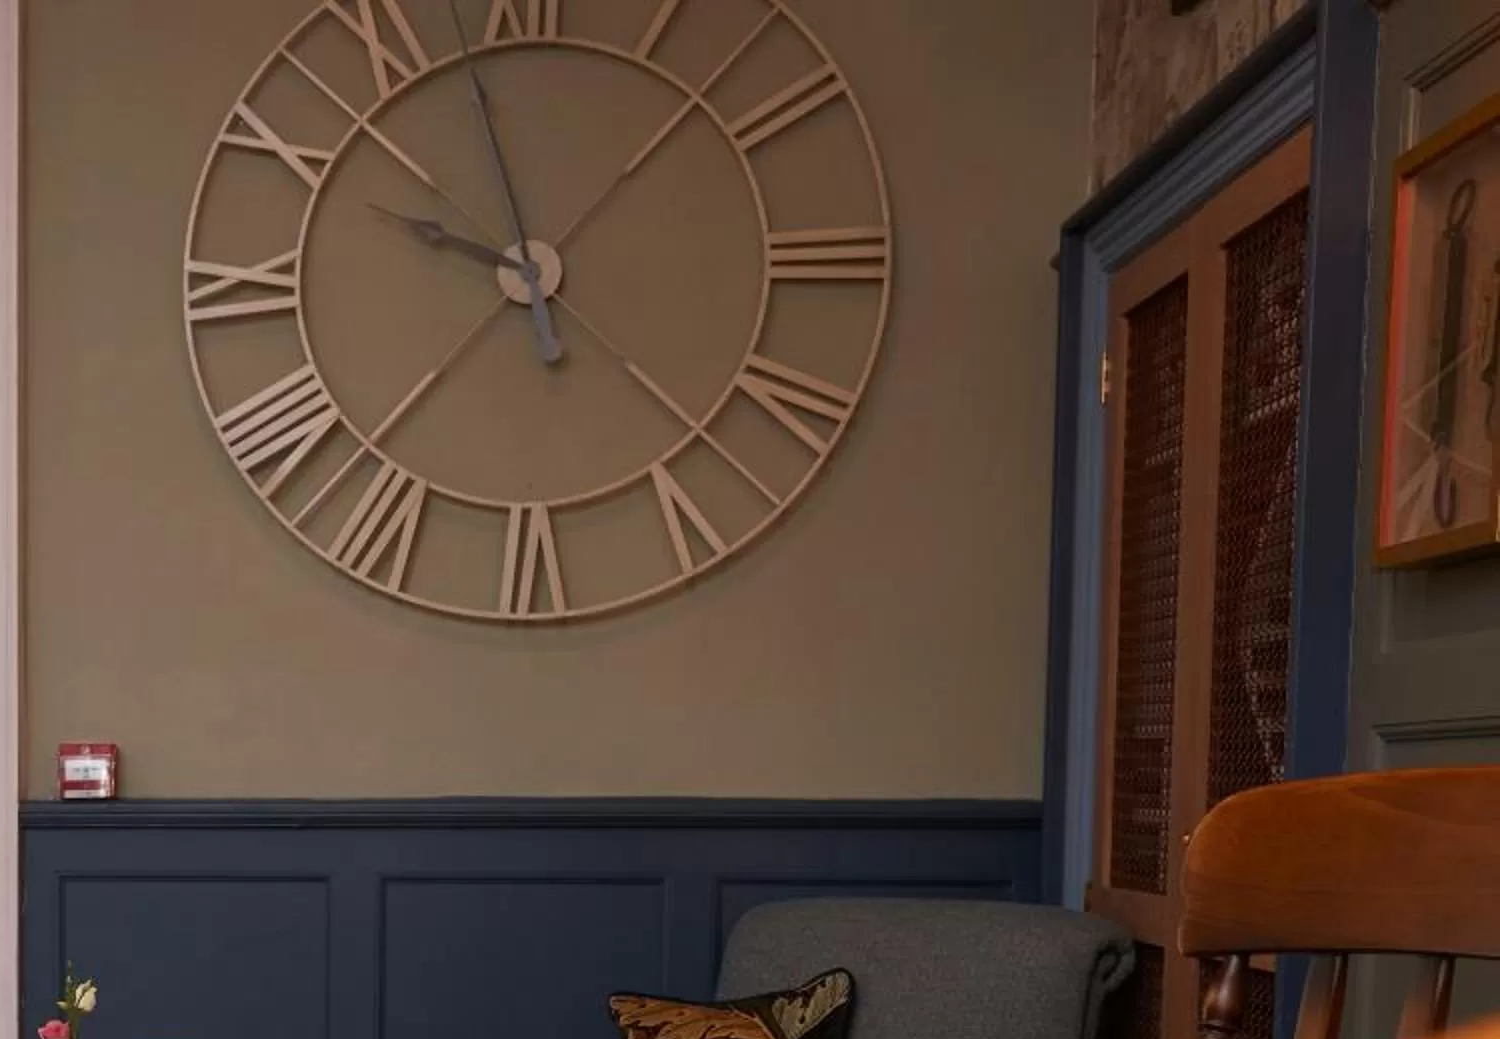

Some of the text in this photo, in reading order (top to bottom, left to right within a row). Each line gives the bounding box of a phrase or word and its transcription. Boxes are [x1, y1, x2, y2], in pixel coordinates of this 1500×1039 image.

[217, 101, 337, 190] X
[722, 61, 850, 152] II
[186, 246, 301, 322] IX
[765, 226, 888, 281] III
[215, 361, 341, 500] VIII
[735, 352, 860, 459] IV
[326, 459, 429, 593] VII
[500, 502, 566, 619] VI
[648, 460, 730, 575] V
